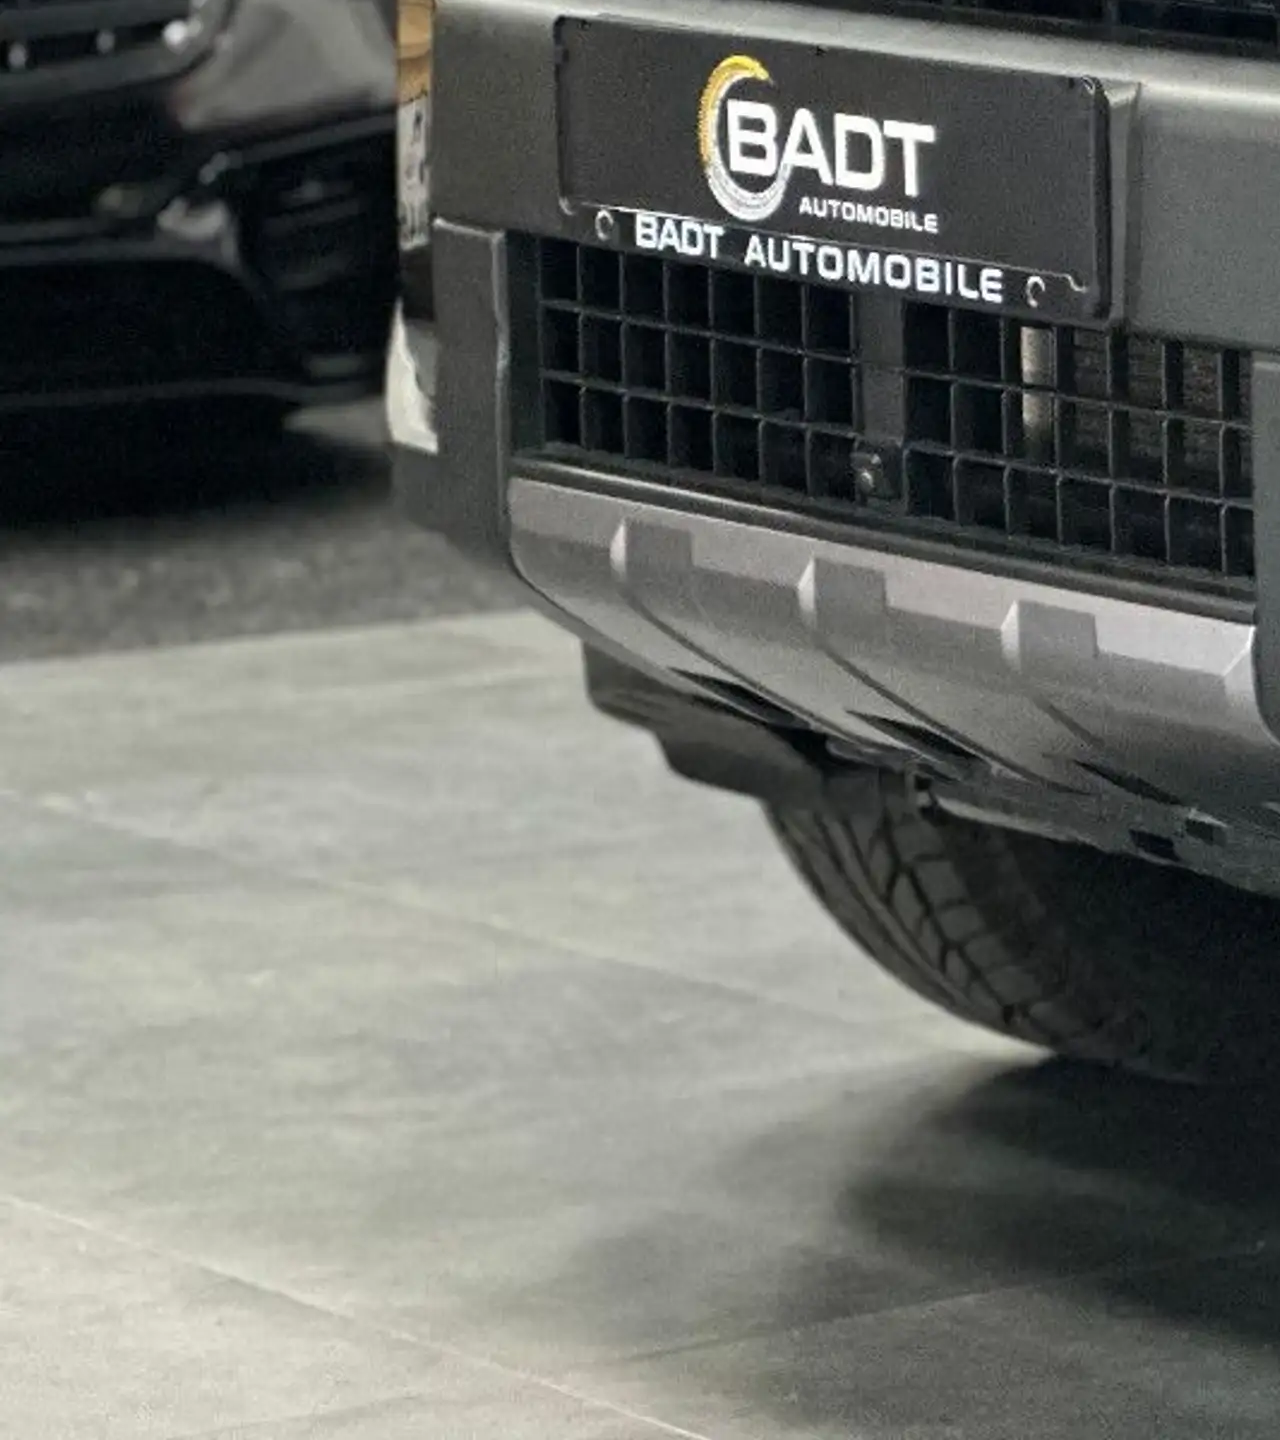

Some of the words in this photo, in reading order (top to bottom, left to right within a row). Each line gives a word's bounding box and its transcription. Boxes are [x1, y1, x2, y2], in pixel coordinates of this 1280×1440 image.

[726, 98, 937, 197] BADT
[634, 212, 726, 260] BADT
[743, 235, 1005, 304] AUTOMOBILE
[799, 196, 939, 234] AUTOMOBILE
